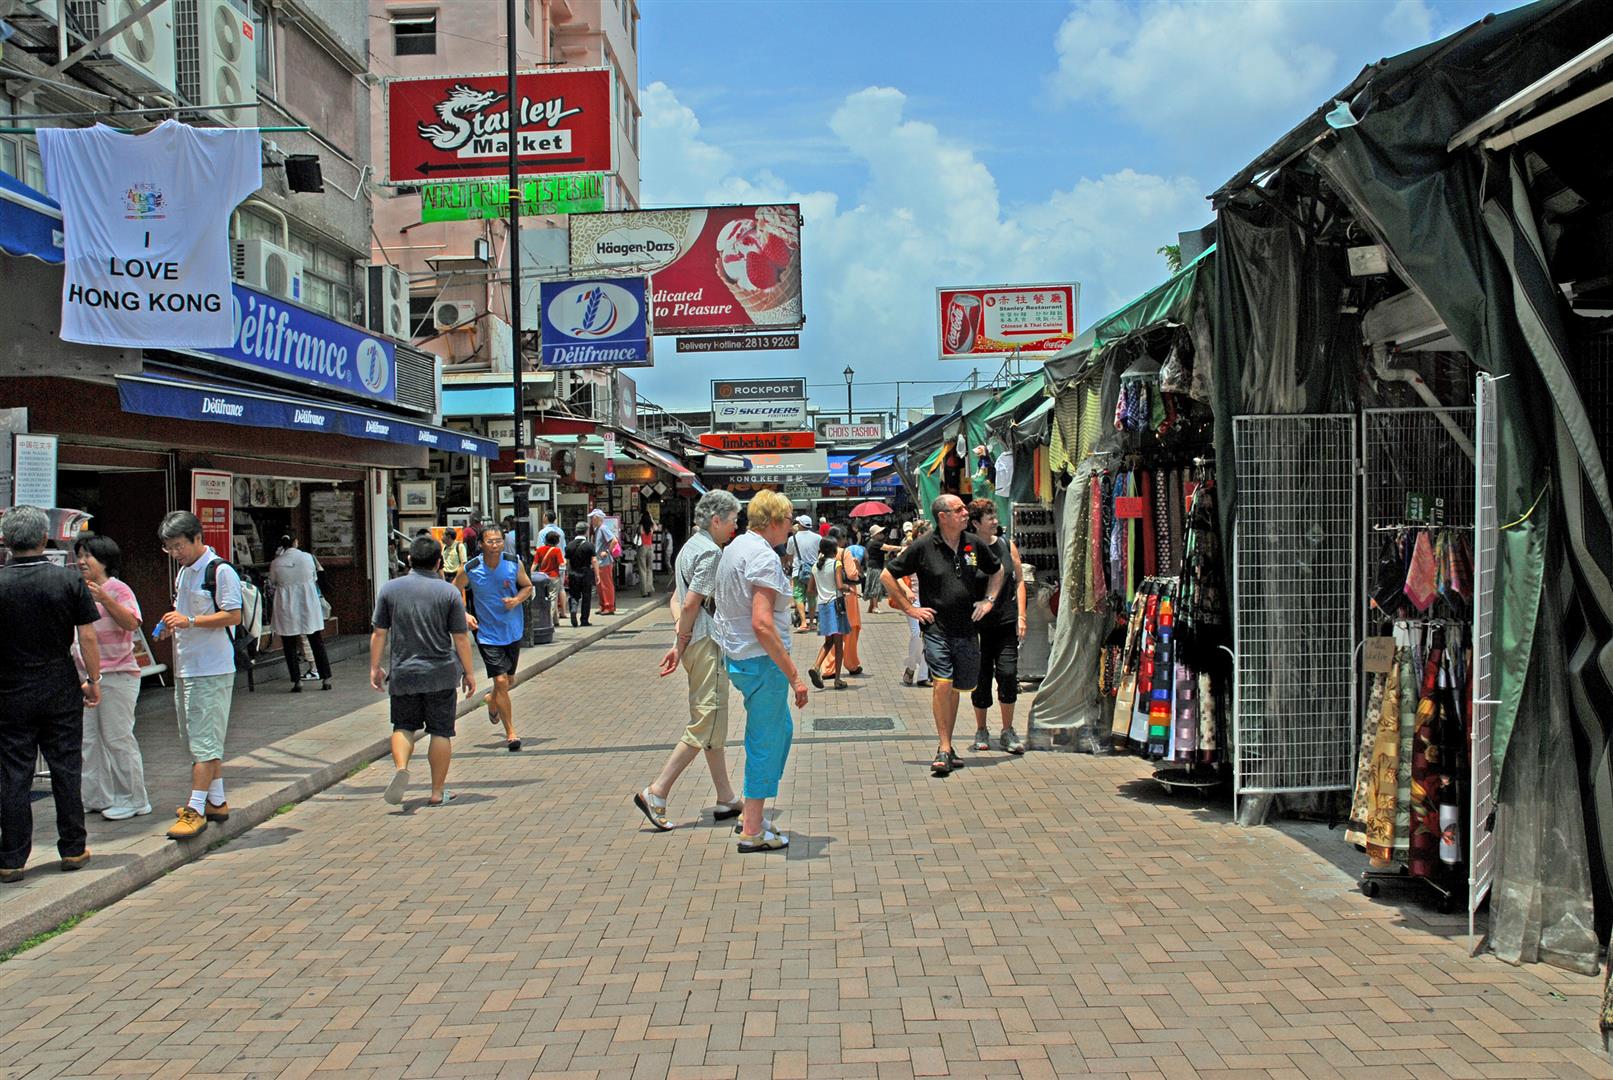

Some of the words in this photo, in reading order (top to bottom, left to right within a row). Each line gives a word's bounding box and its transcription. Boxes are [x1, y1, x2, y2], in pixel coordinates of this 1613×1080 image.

[473, 135, 562, 154] Maket
[421, 184, 466, 210] WORLD
[557, 175, 605, 201] FUSION
[497, 202, 557, 218] UPTAIRS
[144, 231, 150, 248] I
[596, 240, 675, 256] Häagen-Dazs
[110, 257, 179, 280] LOVE
[68, 284, 140, 311] HONG
[149, 293, 221, 312] KONG
[653, 287, 703, 303] dicated
[655, 306, 669, 317] to
[672, 303, 732, 316] Pleasure
[679, 341, 712, 351] Delivery
[713, 340, 745, 349] Hotline:
[745, 337, 770, 348] 2813
[771, 336, 796, 347] 9262
[550, 345, 637, 364] Délifrance
[734, 385, 796, 394] ROCKPORT
[739, 406, 801, 414] SKECHERS
[851, 426, 879, 437] FASHION
[719, 435, 777, 449] Timberland
[729, 475, 757, 483] KONG
